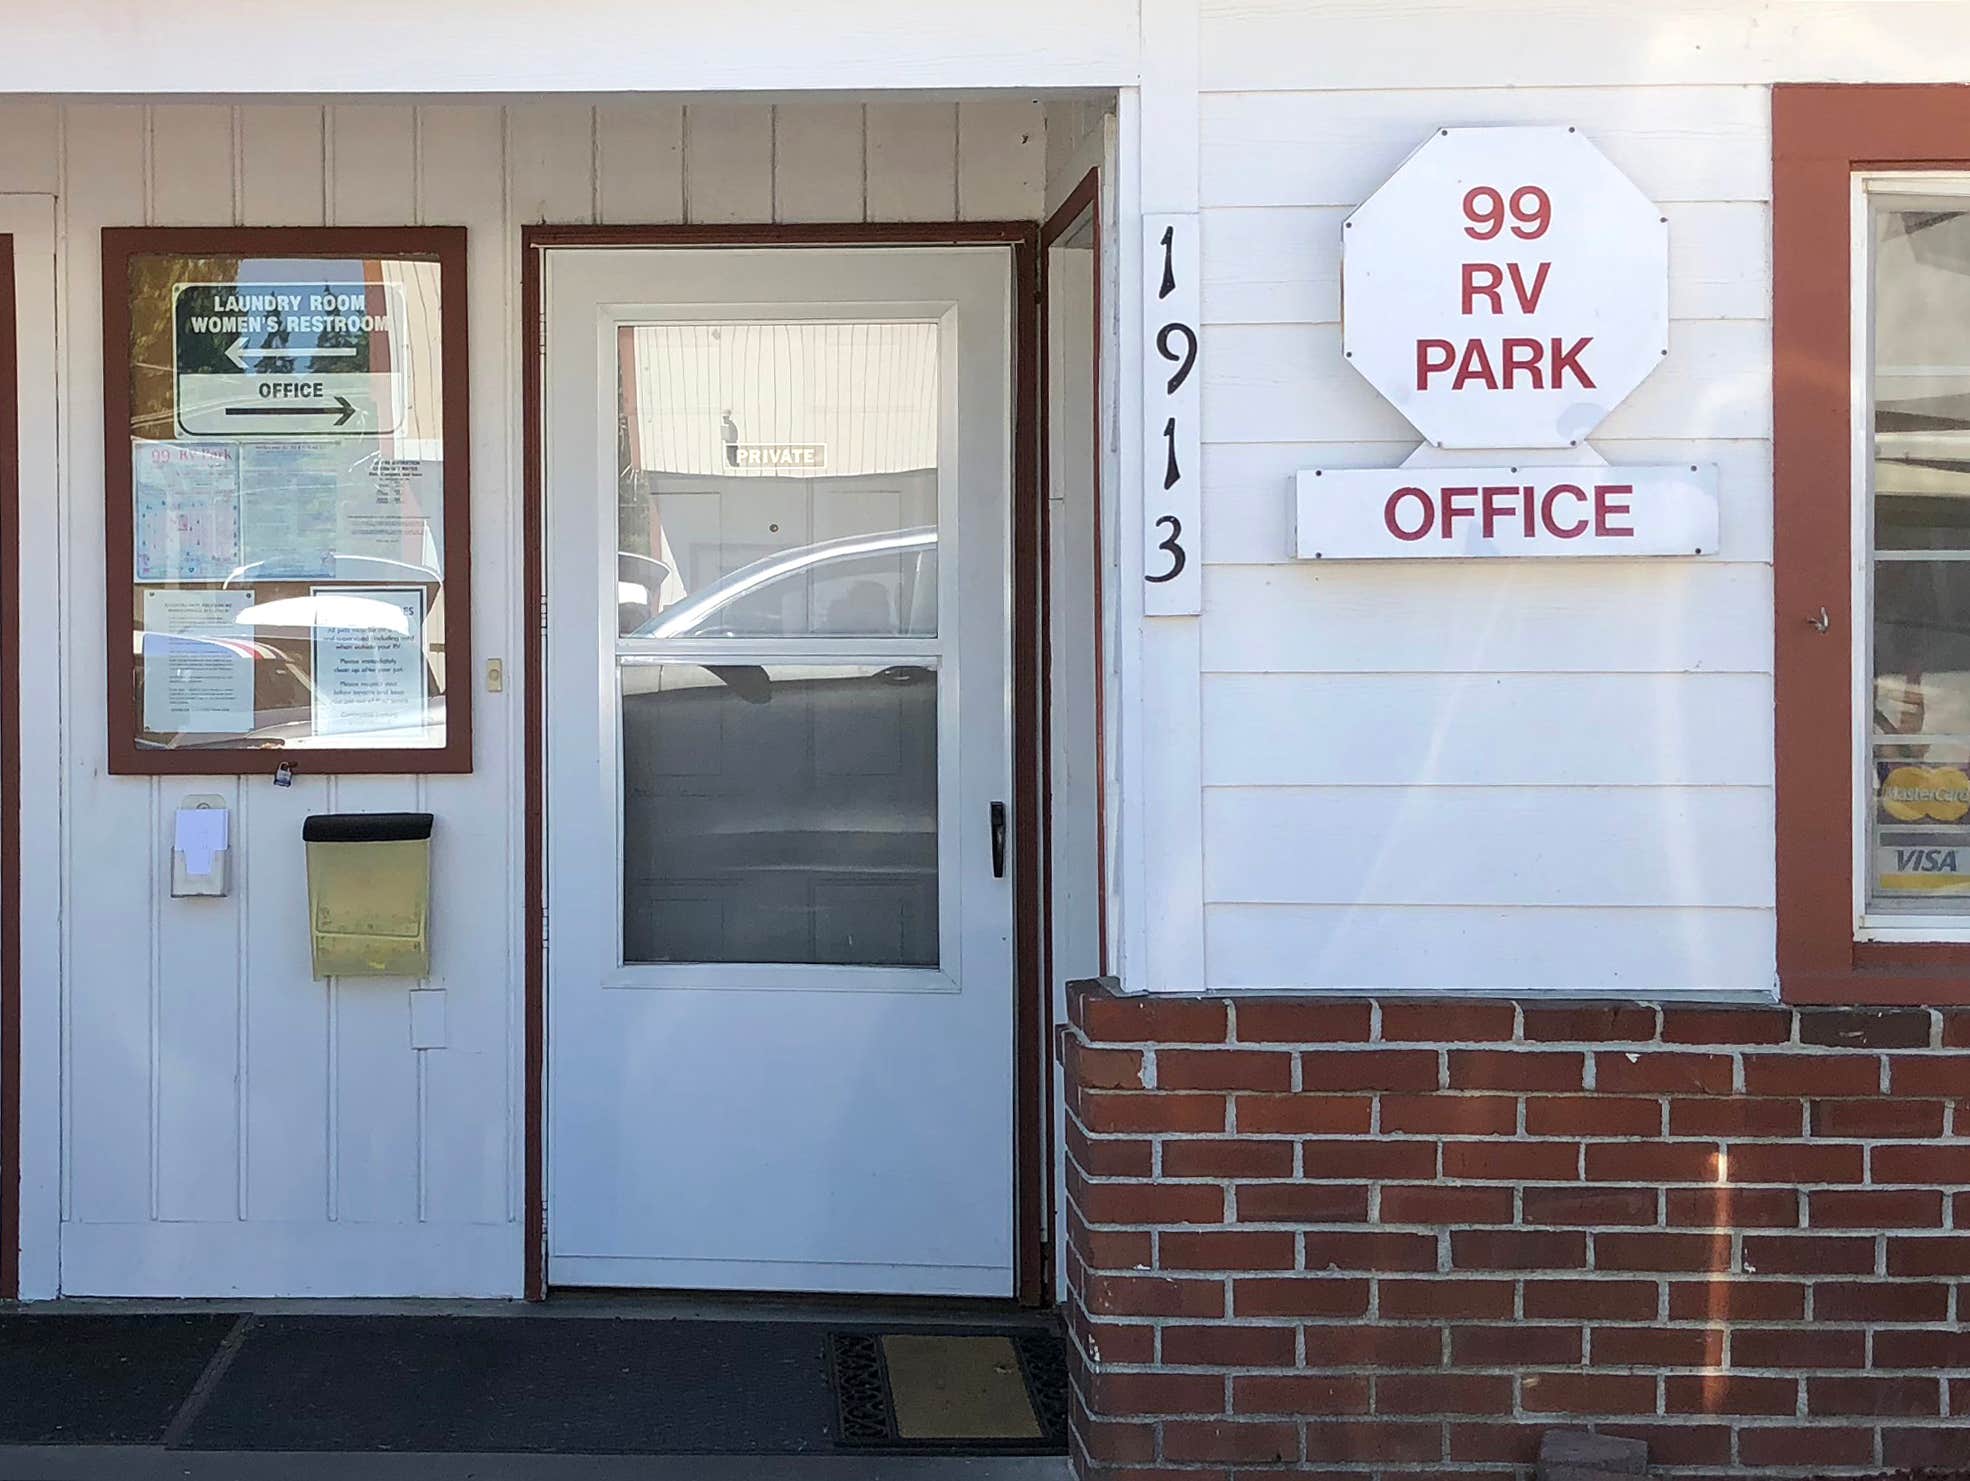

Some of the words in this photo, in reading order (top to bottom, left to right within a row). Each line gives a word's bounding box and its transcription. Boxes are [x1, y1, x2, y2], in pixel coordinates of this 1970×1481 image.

[1463, 186, 1552, 241] 99
[213, 295, 302, 312] LAUNDRY
[309, 294, 366, 312] ROOM
[1460, 262, 1551, 316] RV
[191, 315, 279, 334] WOMEN'S
[286, 314, 390, 333] RESTROOM
[1416, 337, 1597, 391] PARK
[258, 382, 324, 399] OFFICE
[1144, 225, 1198, 583] 1913
[736, 448, 816, 464] PRIVATE
[1384, 484, 1635, 541] OFFICE
[1896, 849, 1959, 872] VISA
